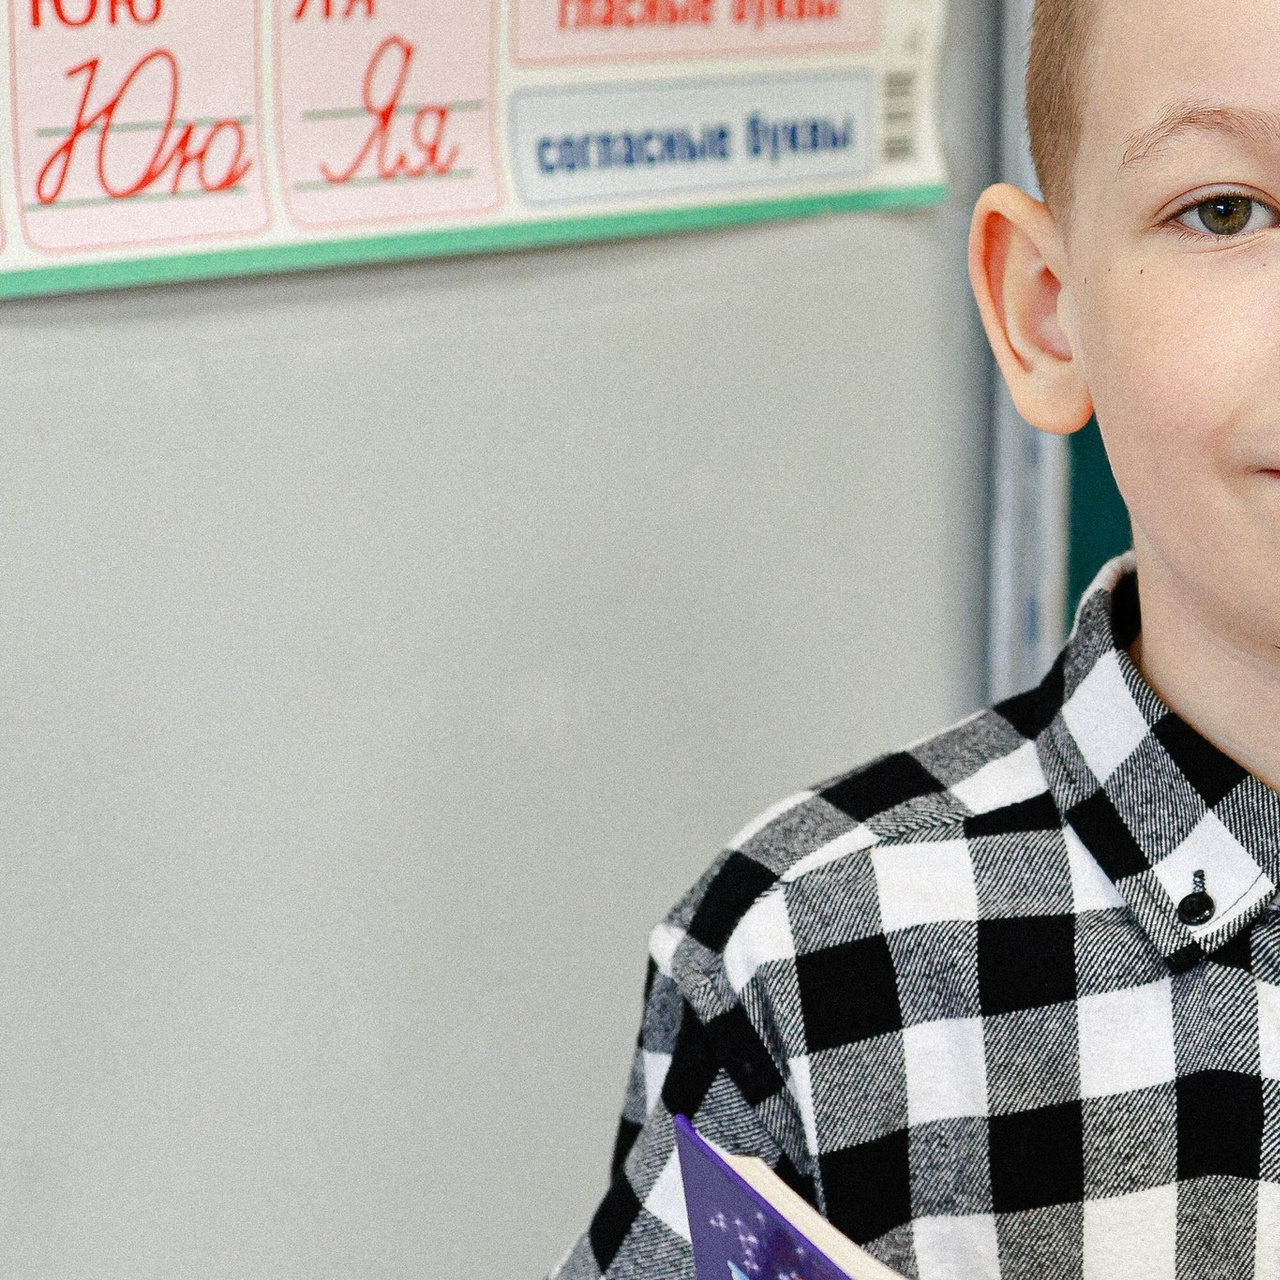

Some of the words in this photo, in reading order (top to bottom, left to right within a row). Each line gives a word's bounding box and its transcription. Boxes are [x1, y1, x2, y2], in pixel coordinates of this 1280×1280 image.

[37, 48, 252, 206] Юю
[320, 34, 460, 185] Яя
[536, 125, 730, 174] согласные
[746, 110, 856, 166] буквы
